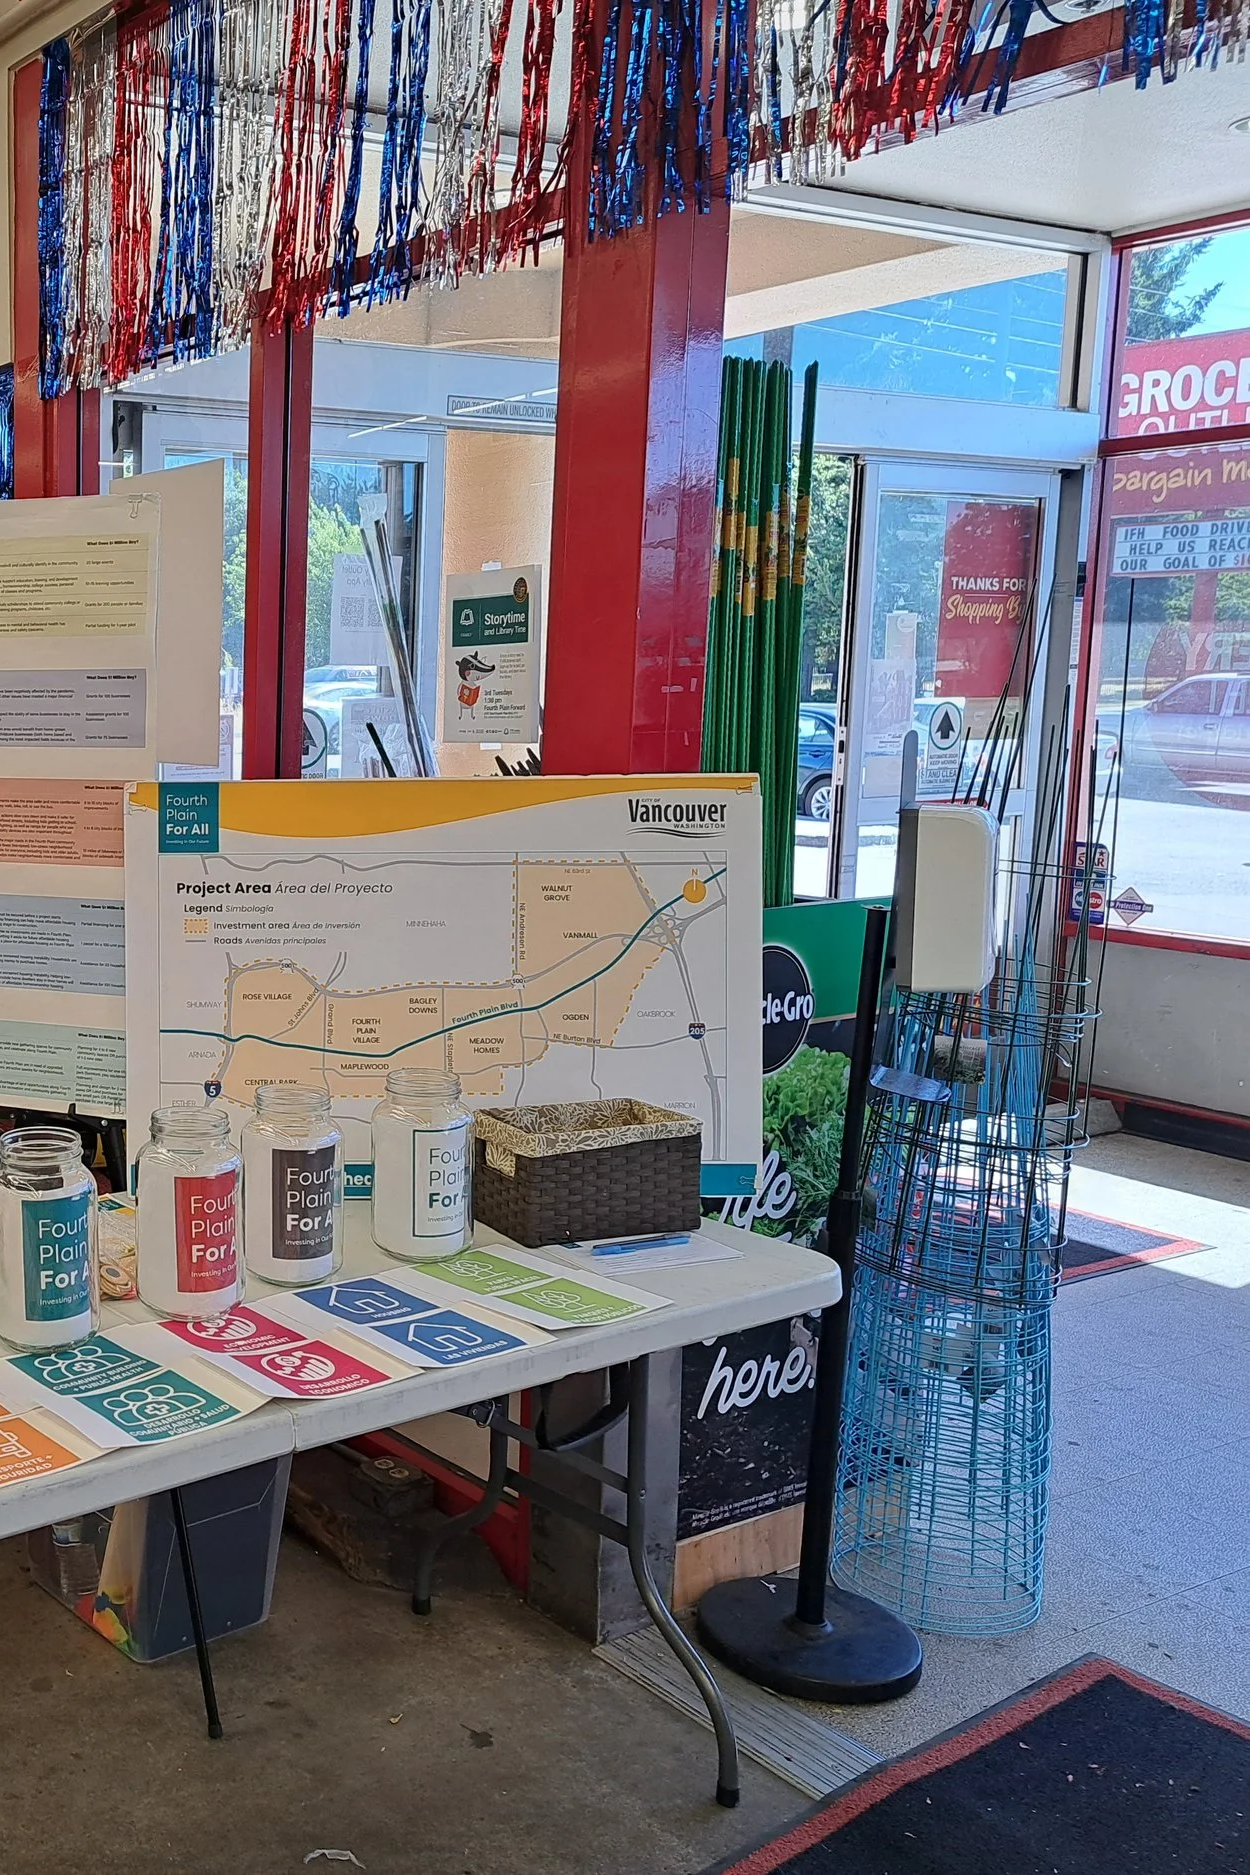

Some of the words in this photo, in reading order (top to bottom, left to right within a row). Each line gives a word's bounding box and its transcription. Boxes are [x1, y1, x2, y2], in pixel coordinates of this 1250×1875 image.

[510, 404, 544, 418] UNLOCKED
[1163, 525, 1199, 539] FOOD
[1129, 541, 1163, 555] HELP
[1178, 539, 1196, 553] US
[1120, 558, 1148, 571] OUR
[1164, 555, 1199, 569] GOAL
[1209, 554, 1226, 568] OF
[951, 576, 1000, 591] THANKS
[1003, 576, 1026, 592] FOR
[946, 594, 1004, 624] Shopping
[1006, 594, 1026, 624] By
[484, 611, 526, 627] Storytime
[484, 628, 494, 636] and
[495, 626, 514, 636] Library
[515, 625, 526, 633] Time
[166, 794, 208, 806] Fourth
[166, 808, 198, 821] Plain
[628, 798, 727, 823] Vancouver
[166, 824, 188, 836] For
[191, 823, 209, 835] All
[692, 868, 698, 876] N
[176, 882, 231, 898] Project
[235, 882, 271, 894] Area
[275, 880, 306, 894] Área
[309, 882, 331, 894] del
[335, 882, 393, 897] Proyecto
[544, 894, 570, 902] GROVE
[184, 903, 223, 915] Legend
[519, 902, 526, 912] NE
[214, 921, 267, 930] Investment
[269, 922, 290, 930] area
[292, 920, 308, 930] Área
[309, 922, 323, 930] de
[214, 936, 243, 945] Roads
[245, 936, 281, 945] Avenidas
[283, 936, 327, 947] principales
[563, 931, 599, 939] VANMALL
[519, 950, 526, 960] Rd
[186, 1001, 221, 1009] SHUMWAY
[409, 998, 437, 1006] BAGLEY
[327, 1003, 335, 1025] Grand
[452, 1010, 478, 1024] Fourth
[479, 1005, 500, 1018] Plain
[500, 1001, 519, 1013] Blvd
[352, 1036, 381, 1044] VILLAGE
[562, 1034, 585, 1042] Burton
[586, 1036, 601, 1044] Blvd
[340, 1063, 390, 1071] MAPLEWOOD
[209, 1085, 216, 1096] 5
[287, 1188, 331, 1208] Plain
[429, 1192, 459, 1208] For
[191, 1215, 235, 1238] Plain
[286, 1213, 321, 1231] For
[40, 1240, 88, 1265] Plain
[191, 1244, 227, 1263] For
[40, 1269, 78, 1290] For
[191, 1269, 221, 1278] Investing
[40, 1296, 72, 1306] Investing
[370, 1307, 414, 1319] HOUSING
[442, 1353, 460, 1361] LAS
[461, 1340, 509, 1357] VIVIENDAS
[52, 1373, 107, 1391] COMMUNITY
[108, 1359, 147, 1375] BUILDING
[79, 1378, 112, 1391] PUBLIC
[113, 1367, 144, 1381] HEALTH
[300, 1373, 362, 1390] DESARROLLO
[697, 1346, 815, 1420] here.
[129, 1418, 193, 1437] COMUNITARIO
[201, 1404, 230, 1418] SALUD
[143, 1408, 201, 1428] DESARROLLO
